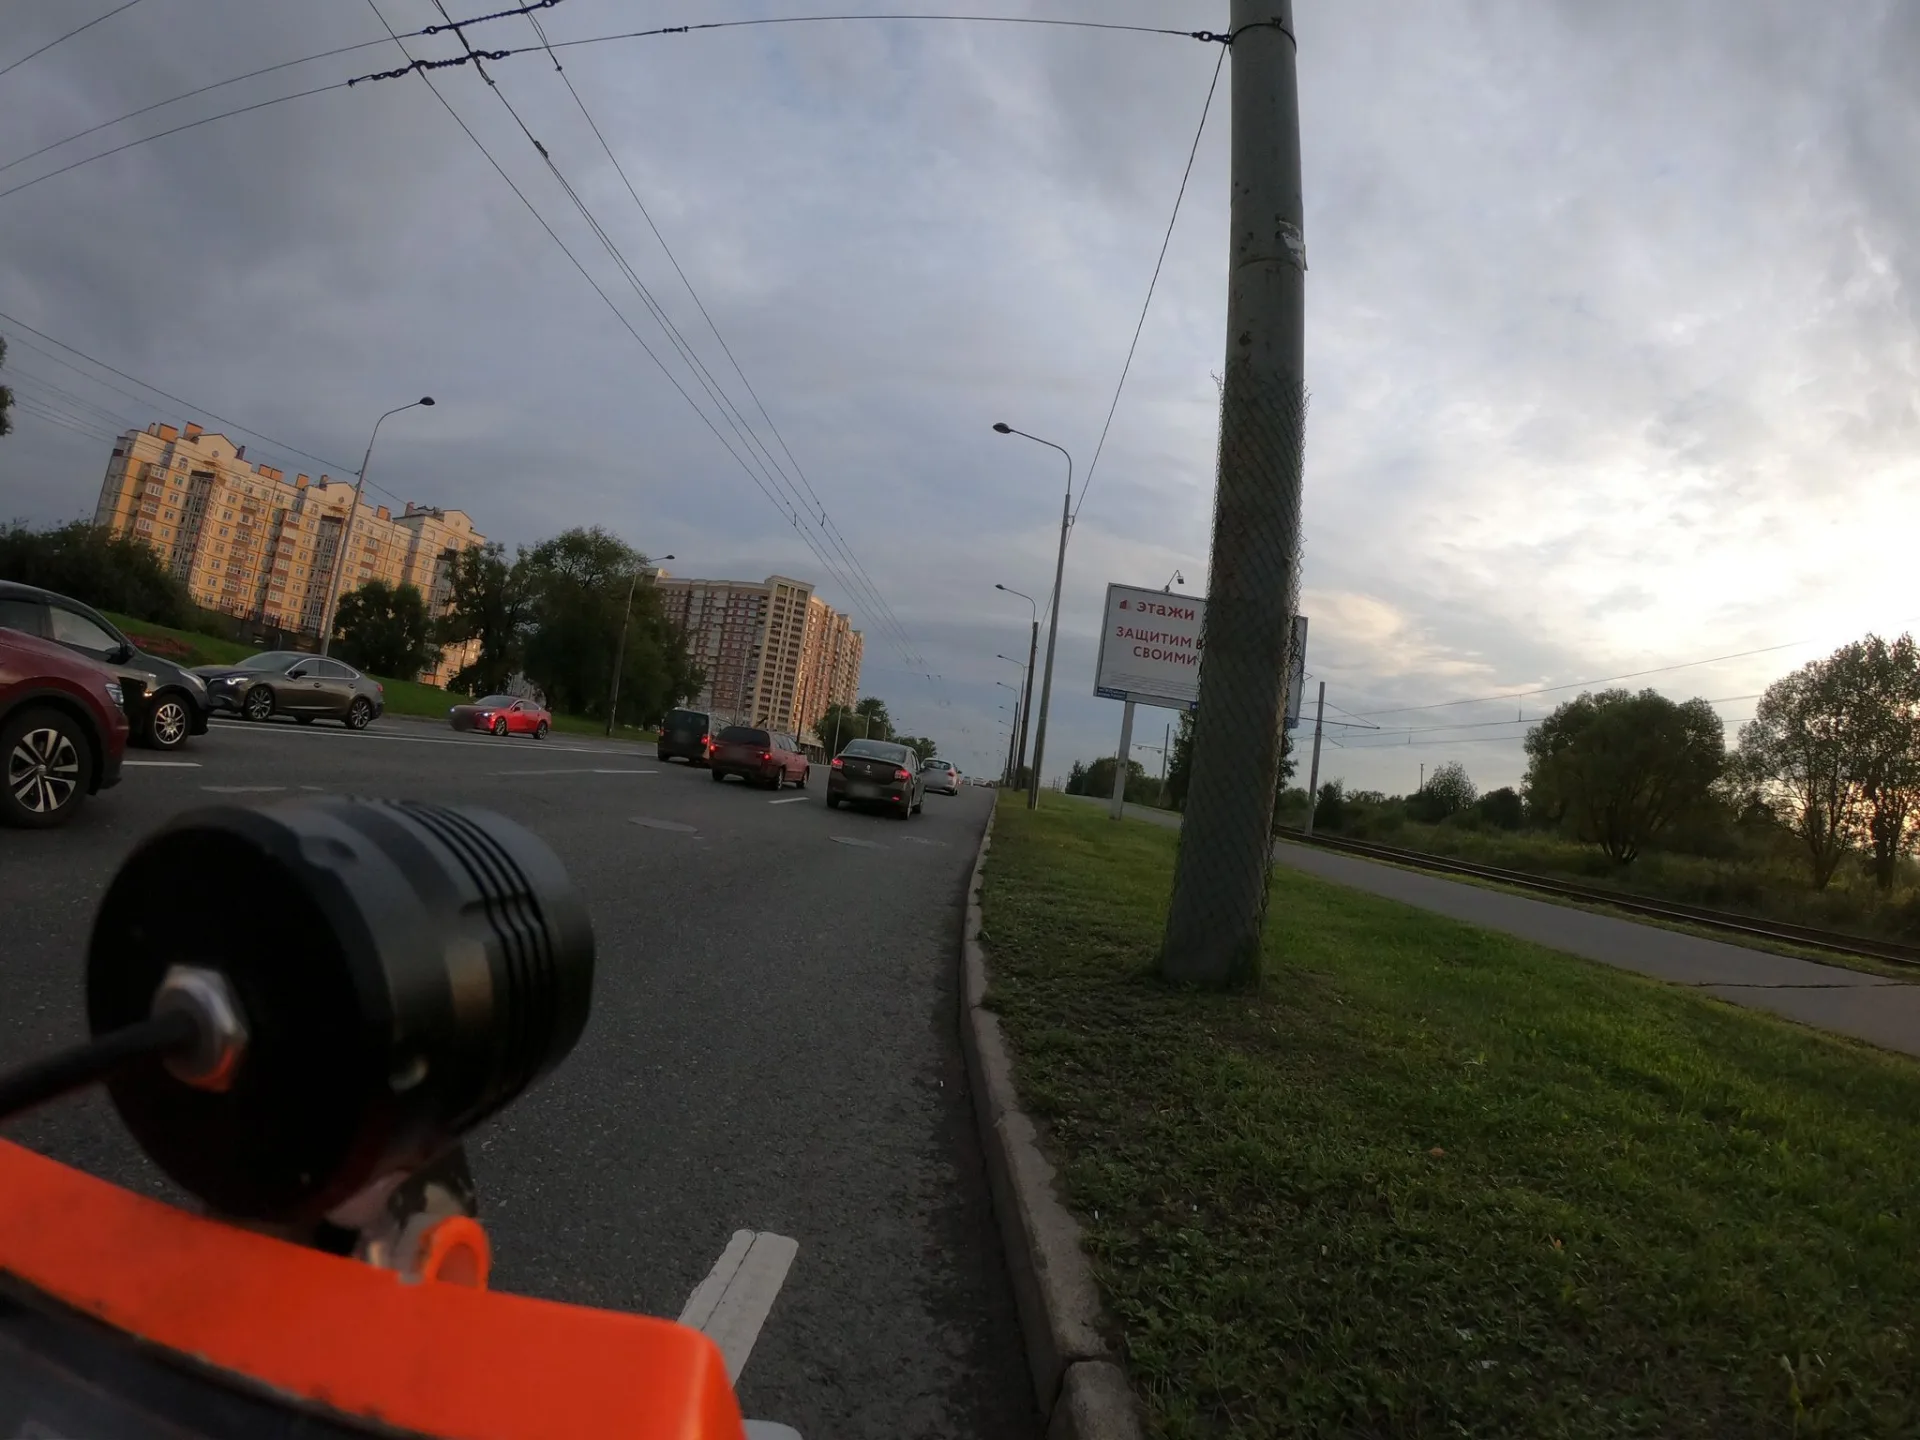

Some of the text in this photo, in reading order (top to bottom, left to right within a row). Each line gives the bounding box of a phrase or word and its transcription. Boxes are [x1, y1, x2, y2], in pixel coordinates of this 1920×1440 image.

[1136, 601, 1195, 621] этажи
[1115, 626, 1192, 648] ЗАЩИТИМ
[1133, 646, 1197, 666] СВОИМИ
